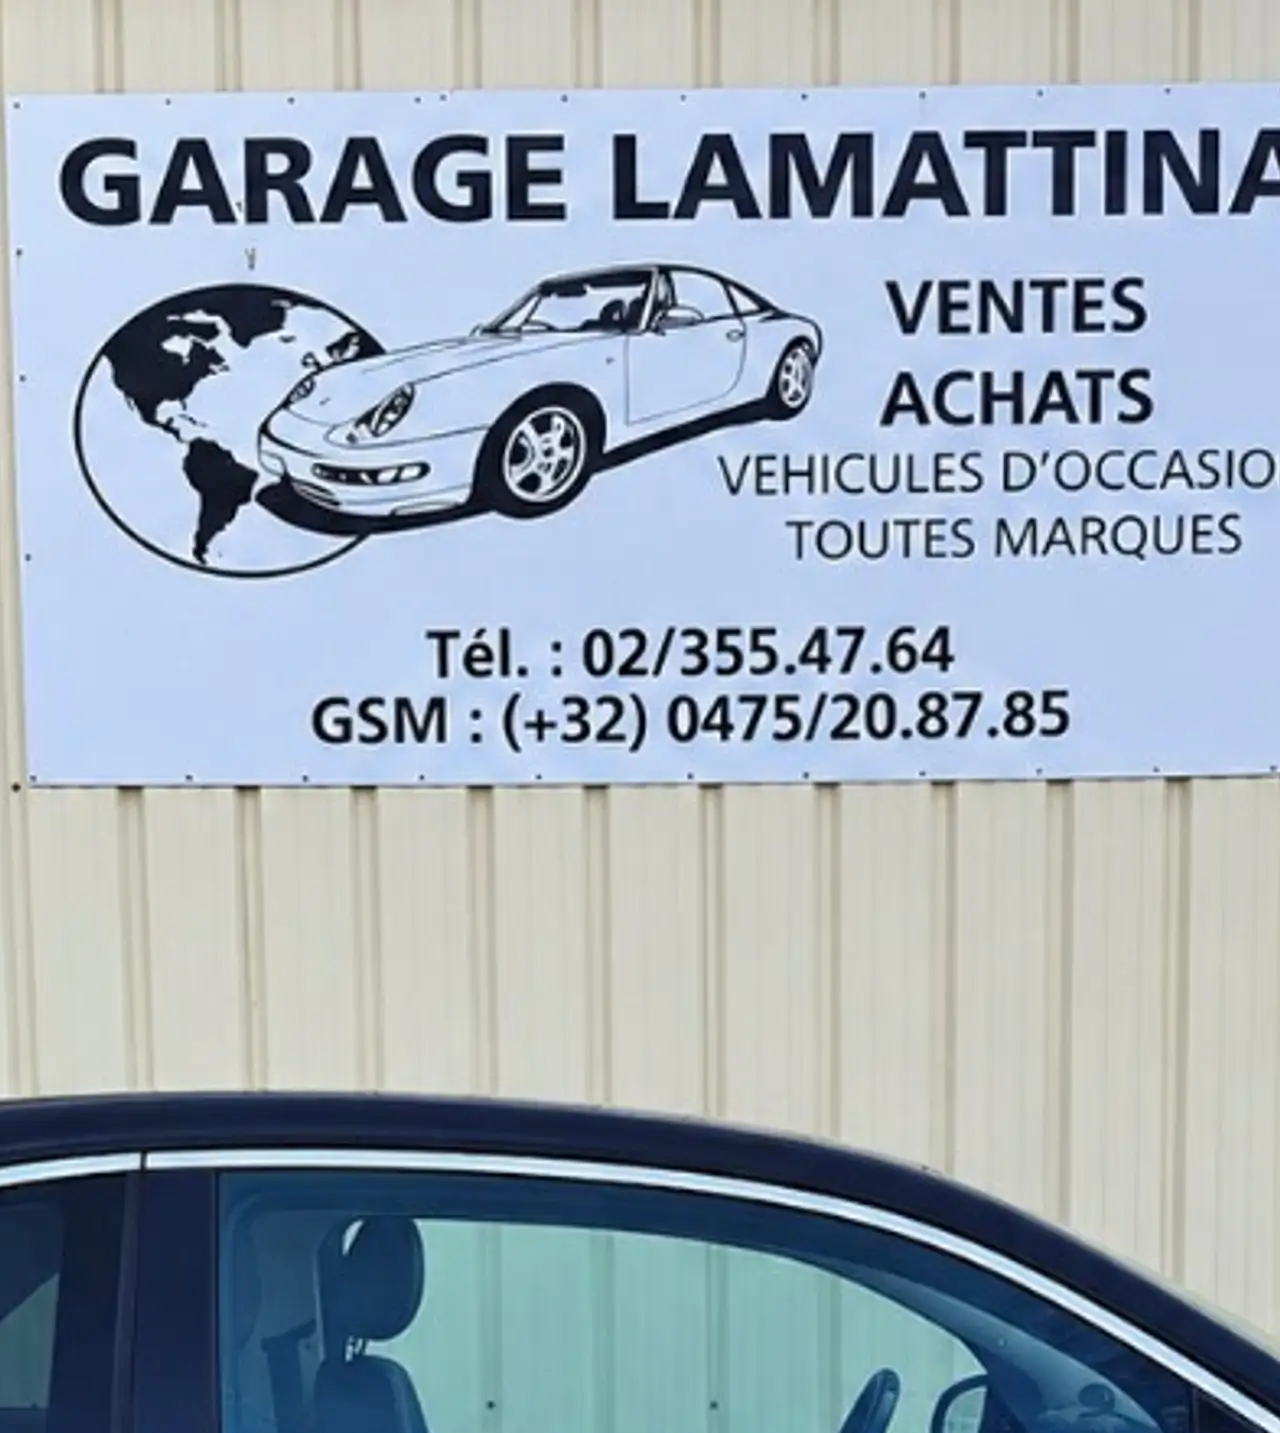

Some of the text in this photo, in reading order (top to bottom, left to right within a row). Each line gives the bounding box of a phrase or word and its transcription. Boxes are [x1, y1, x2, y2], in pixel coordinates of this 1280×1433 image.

[59, 133, 568, 227] GARAGE
[885, 276, 1148, 335] VENTES
[879, 367, 1154, 427] ACHATS
[717, 451, 985, 496] VEHICULES
[784, 513, 1243, 561] TOUTES MARQUES
[425, 627, 529, 679] Tél.
[582, 625, 956, 678] 02/355.47.64
[312, 696, 447, 745] GSM
[503, 692, 647, 753] (+32)
[667, 689, 1070, 744] 0475/20.87.85
